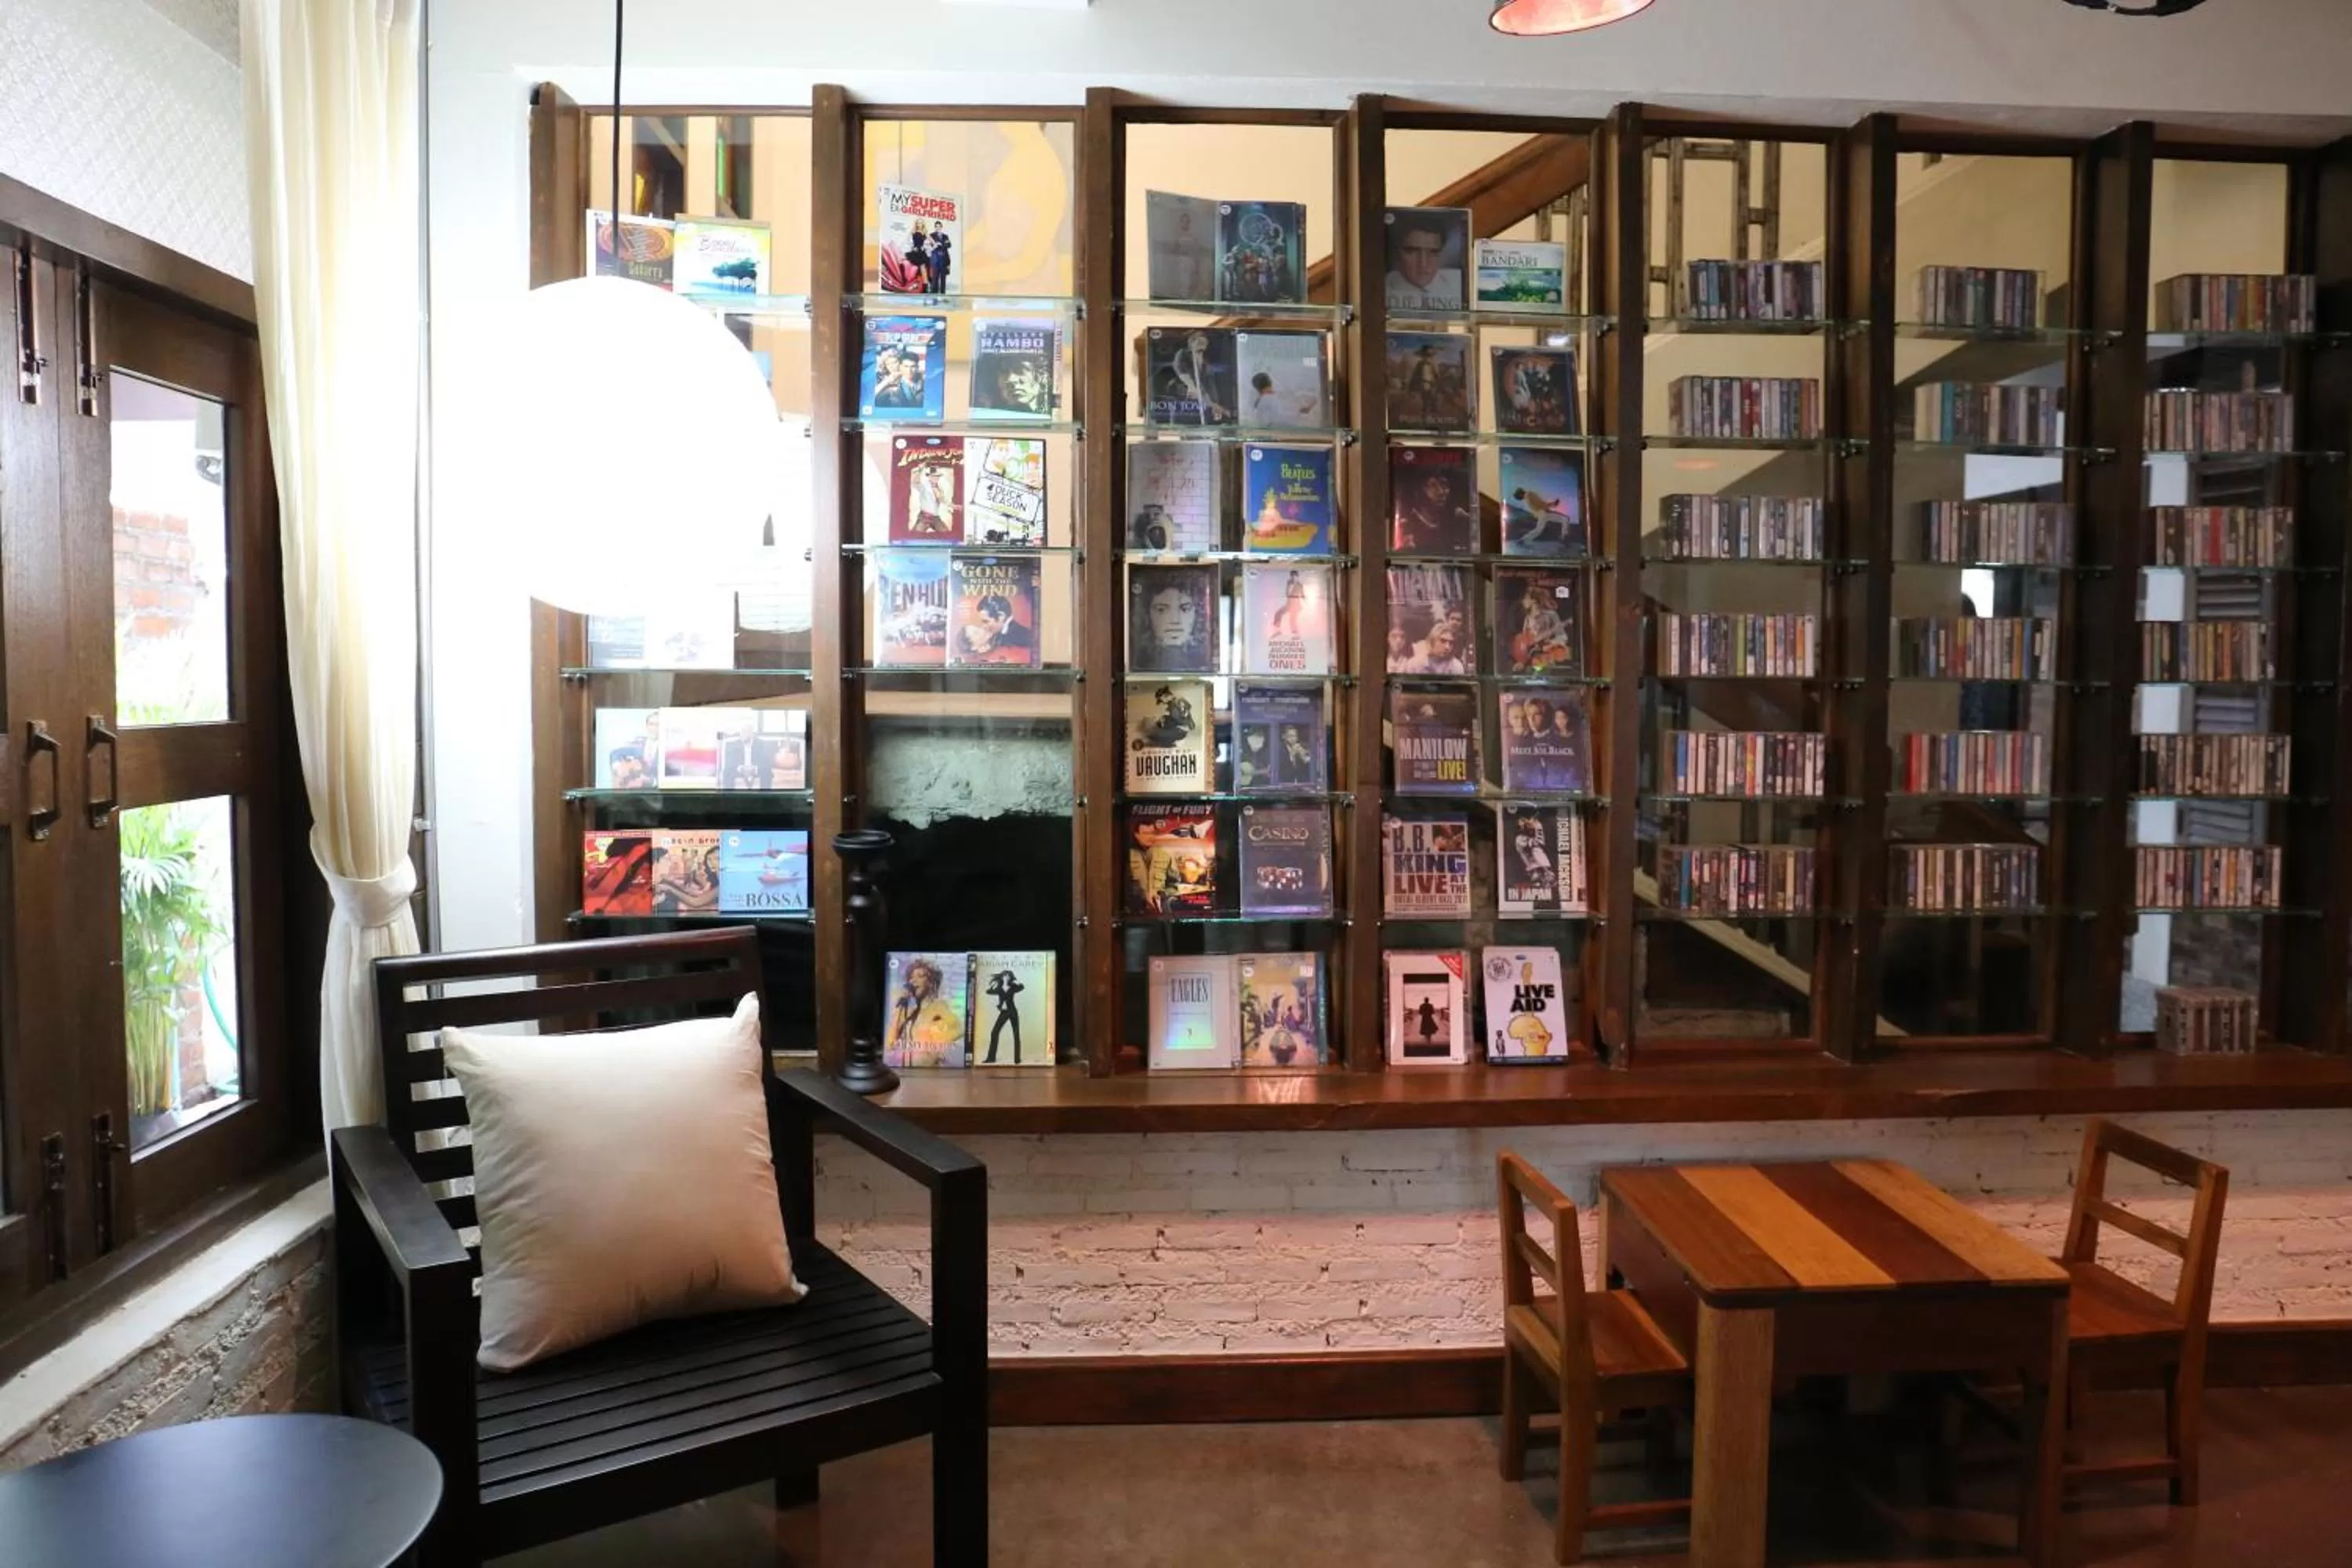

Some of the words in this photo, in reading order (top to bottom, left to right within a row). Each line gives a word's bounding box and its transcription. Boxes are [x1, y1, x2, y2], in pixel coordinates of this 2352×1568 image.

[910, 195, 956, 213] SUPER
[1481, 256, 1538, 267] BANDARI
[981, 338, 1045, 348] RAMBO
[995, 485, 1024, 500] DUCK
[986, 492, 1029, 512] SEASON
[961, 565, 1019, 579] GONE
[963, 584, 1018, 597] WIND
[1399, 739, 1468, 760] MANILOW
[1137, 754, 1197, 777] VAUGHAN
[1437, 760, 1467, 780] LIVE!
[1132, 805, 1171, 815] FLIGHT
[1182, 804, 1213, 815] FURY
[1248, 826, 1309, 840] CASINO
[1393, 854, 1466, 873] KING
[1393, 874, 1447, 895] LIVE
[1451, 874, 1466, 884] AT
[1558, 854, 1571, 900] JACKSON
[1451, 884, 1468, 895] THE
[1508, 887, 1519, 900] IN
[1520, 887, 1552, 901] JAPAN
[746, 892, 804, 907] BOSSA
[1171, 977, 1209, 1004] EAGLES
[1515, 985, 1555, 998] LIVE
[1511, 999, 1546, 1012] AID
